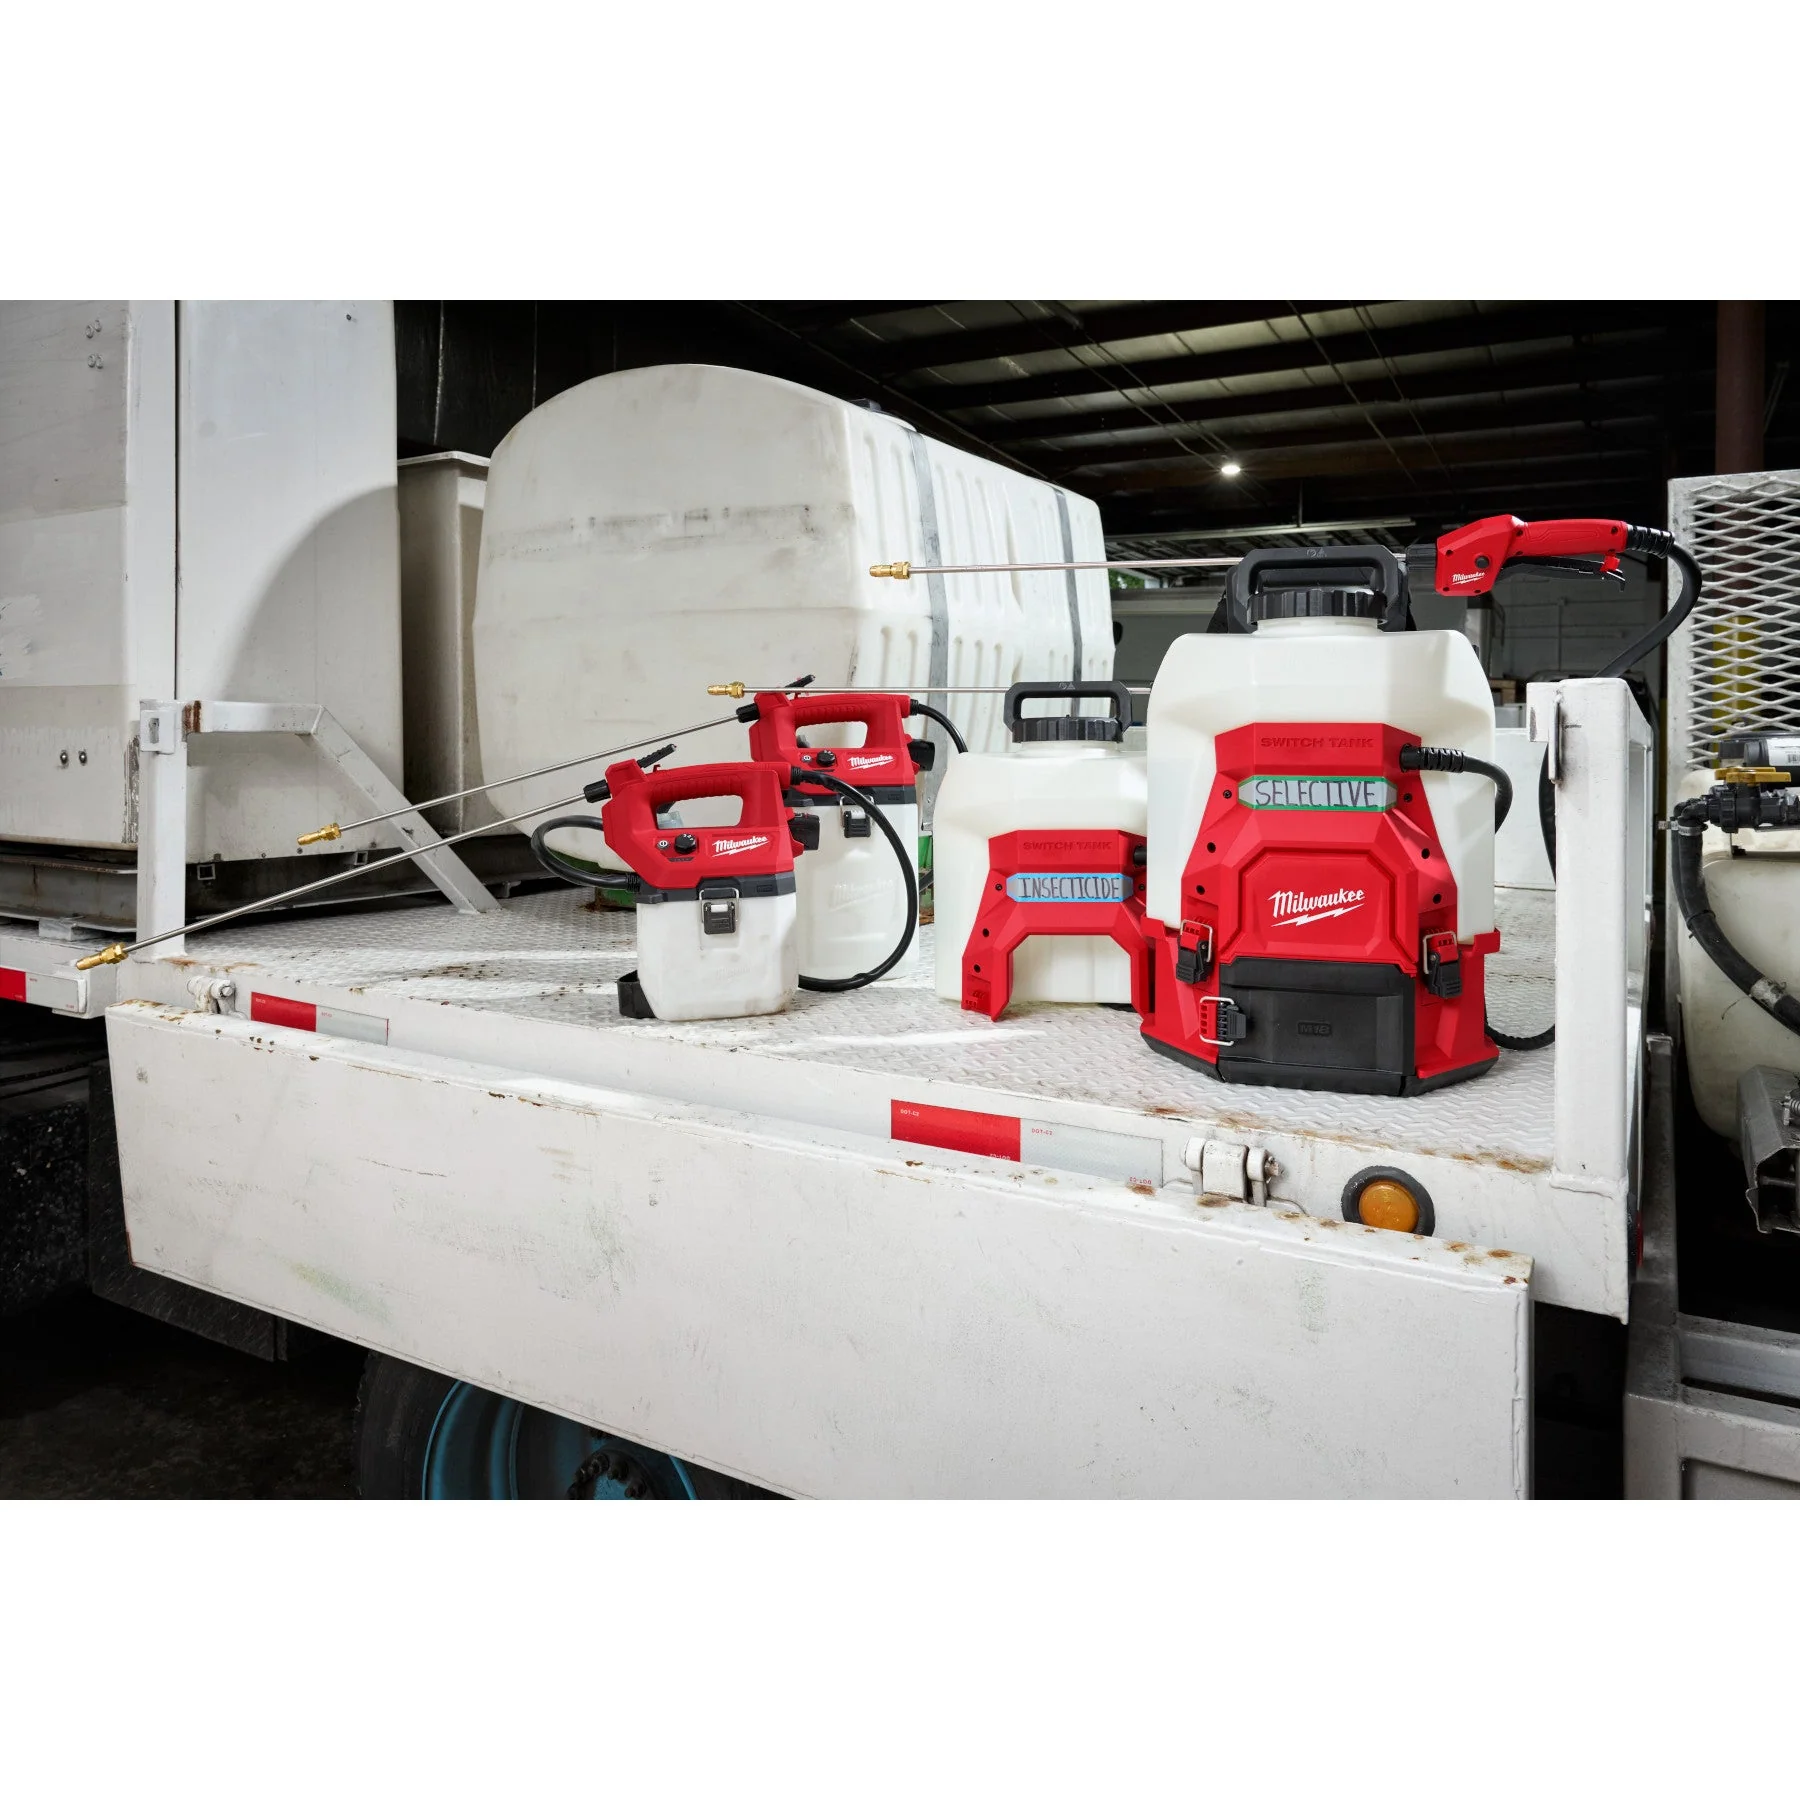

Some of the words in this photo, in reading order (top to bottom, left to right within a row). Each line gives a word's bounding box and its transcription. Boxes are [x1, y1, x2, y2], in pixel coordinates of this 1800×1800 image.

[1452, 571, 1485, 582] Milwaukee
[1261, 737, 1324, 748] SWITCH
[1328, 738, 1375, 748] TANK
[847, 754, 894, 767] Milwaukee
[1255, 780, 1379, 808] SELECTIVE
[711, 835, 768, 853] Milwaukee
[1023, 841, 1073, 851] SWITCH
[1075, 841, 1113, 851] TANK
[1018, 877, 1120, 900] INSECTICIDE
[1267, 888, 1366, 919] Milwaukee
